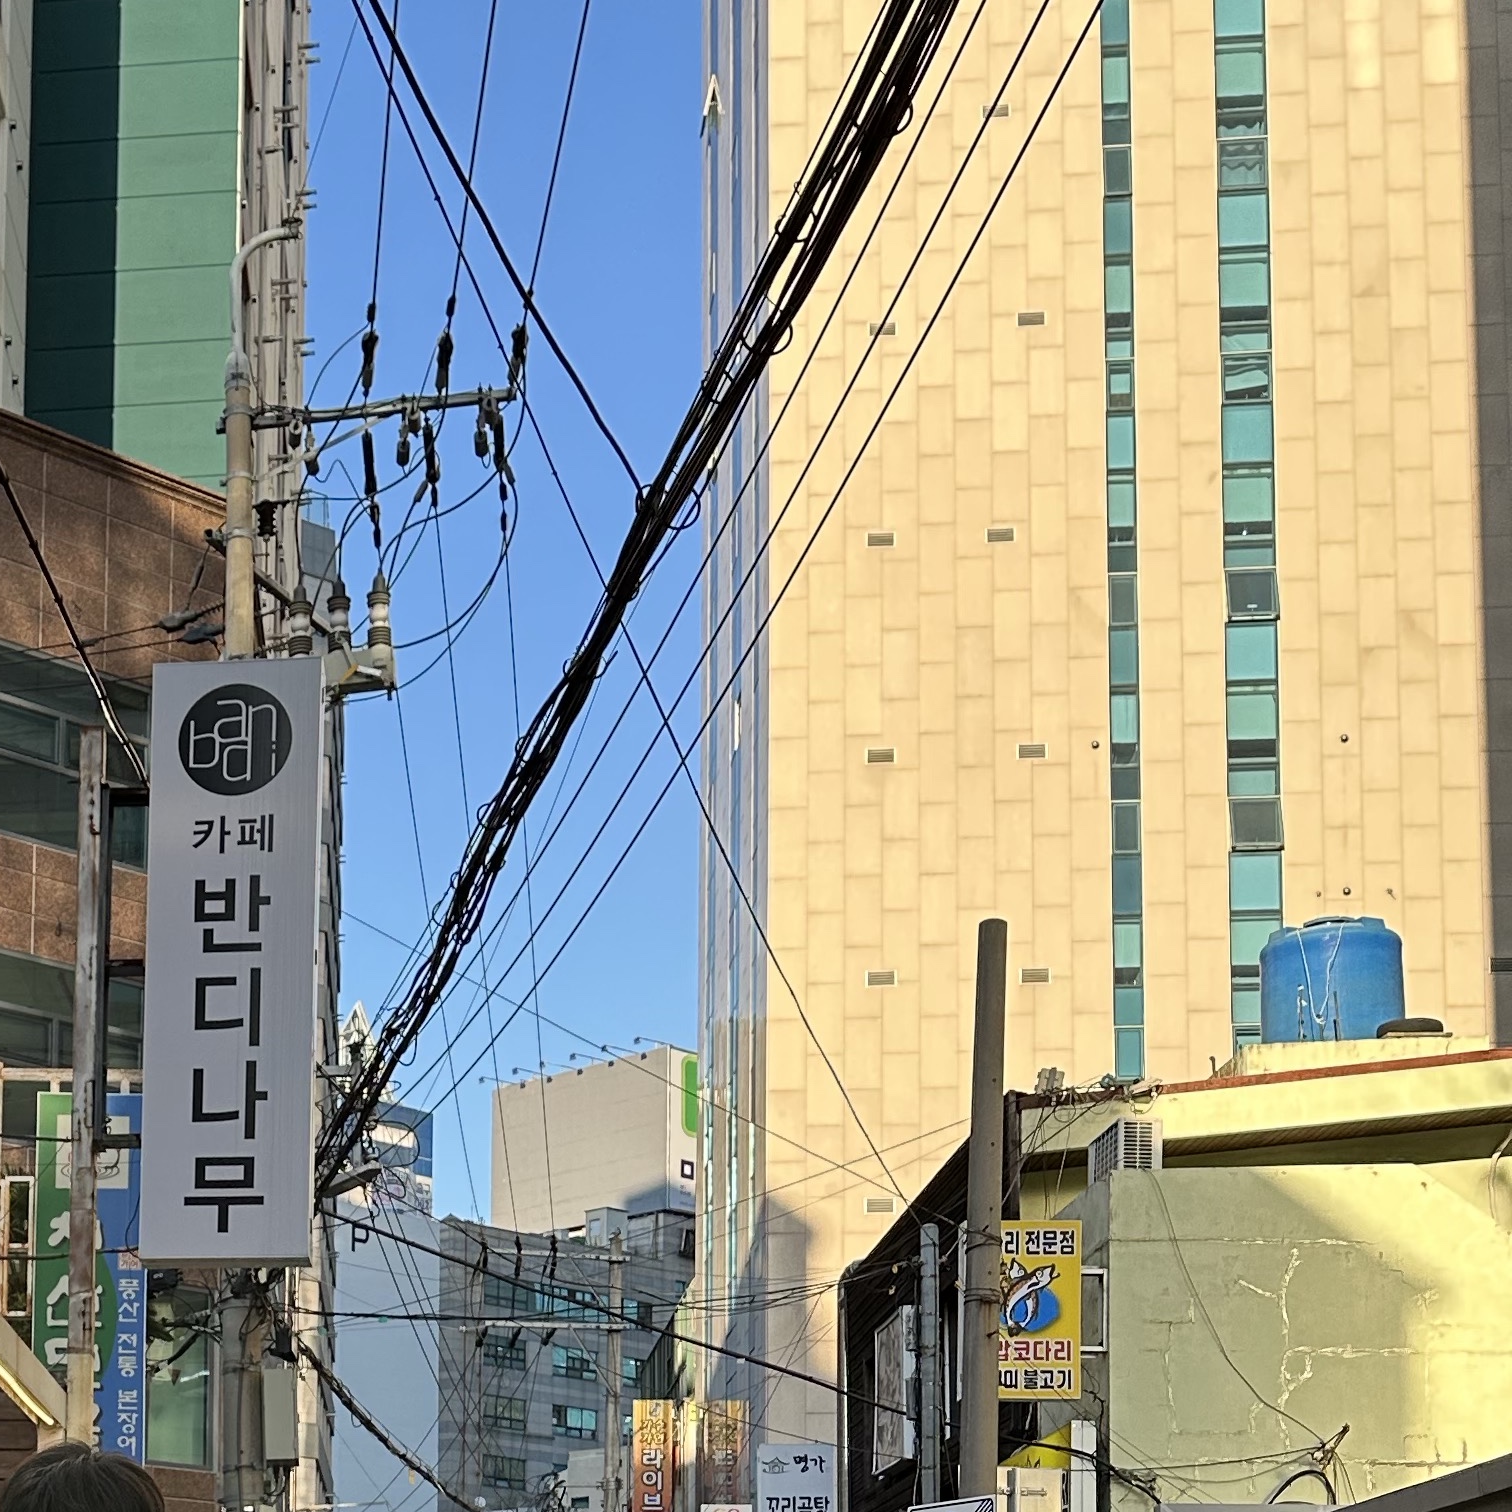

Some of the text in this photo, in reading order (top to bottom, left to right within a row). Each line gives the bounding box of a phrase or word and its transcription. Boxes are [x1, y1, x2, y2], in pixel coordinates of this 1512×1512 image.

[192, 814, 274, 854] 카페
[183, 874, 271, 1233] 반디나무
[1025, 1230, 1075, 1255] 전문점
[117, 1333, 138, 1378] 전통
[1023, 1369, 1072, 1390] 불고기
[642, 1449, 664, 1511] 라이브
[793, 1454, 826, 1474] 명가
